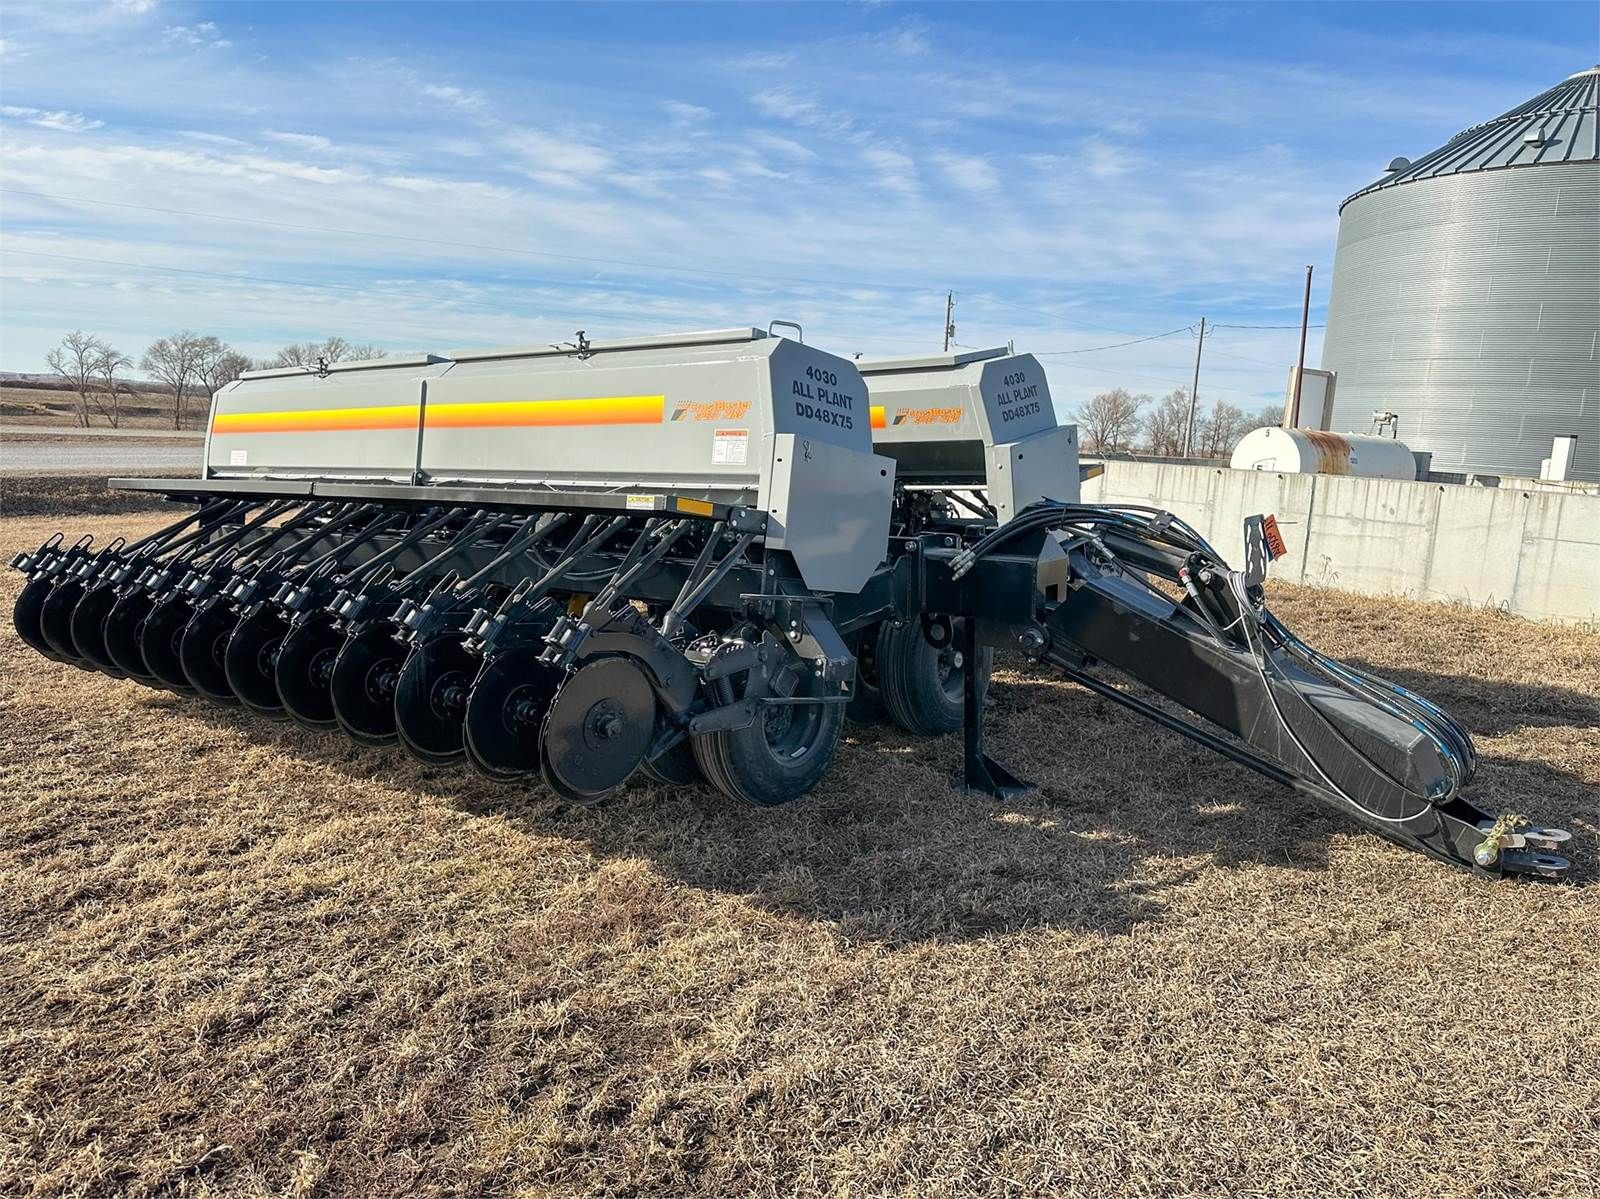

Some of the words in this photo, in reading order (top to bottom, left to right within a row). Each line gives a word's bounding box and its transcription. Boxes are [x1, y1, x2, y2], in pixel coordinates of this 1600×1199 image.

[806, 366, 837, 386] 4030
[1004, 372, 1025, 387] 4030
[793, 380, 814, 400] ALL
[817, 387, 853, 410] PLANT
[998, 392, 1012, 406] ALL
[1013, 385, 1038, 401] PLANT
[1265, 429, 1270, 437] 5
